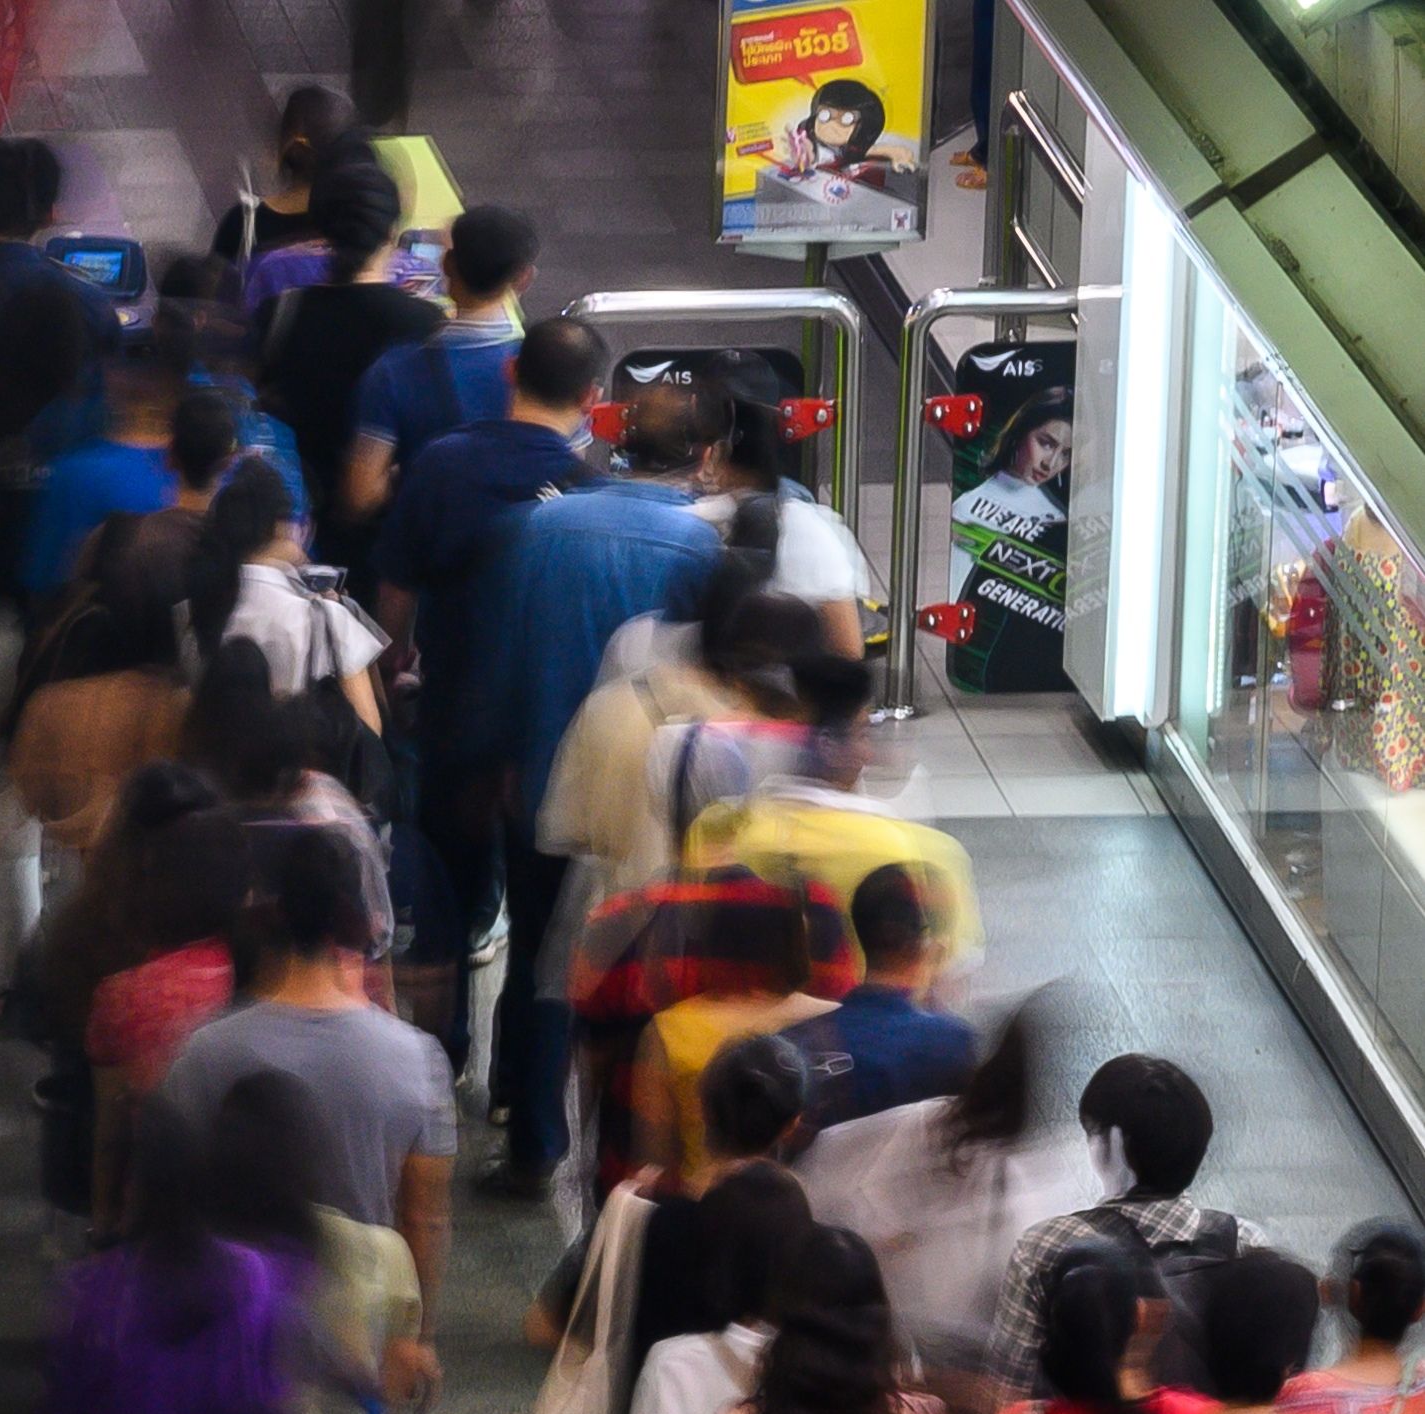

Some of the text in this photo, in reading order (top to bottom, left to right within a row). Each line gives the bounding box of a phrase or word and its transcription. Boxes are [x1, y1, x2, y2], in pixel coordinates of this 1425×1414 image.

[1002, 360, 1036, 377] AIS
[661, 371, 693, 385] AIS
[988, 541, 1052, 582] NEXT
